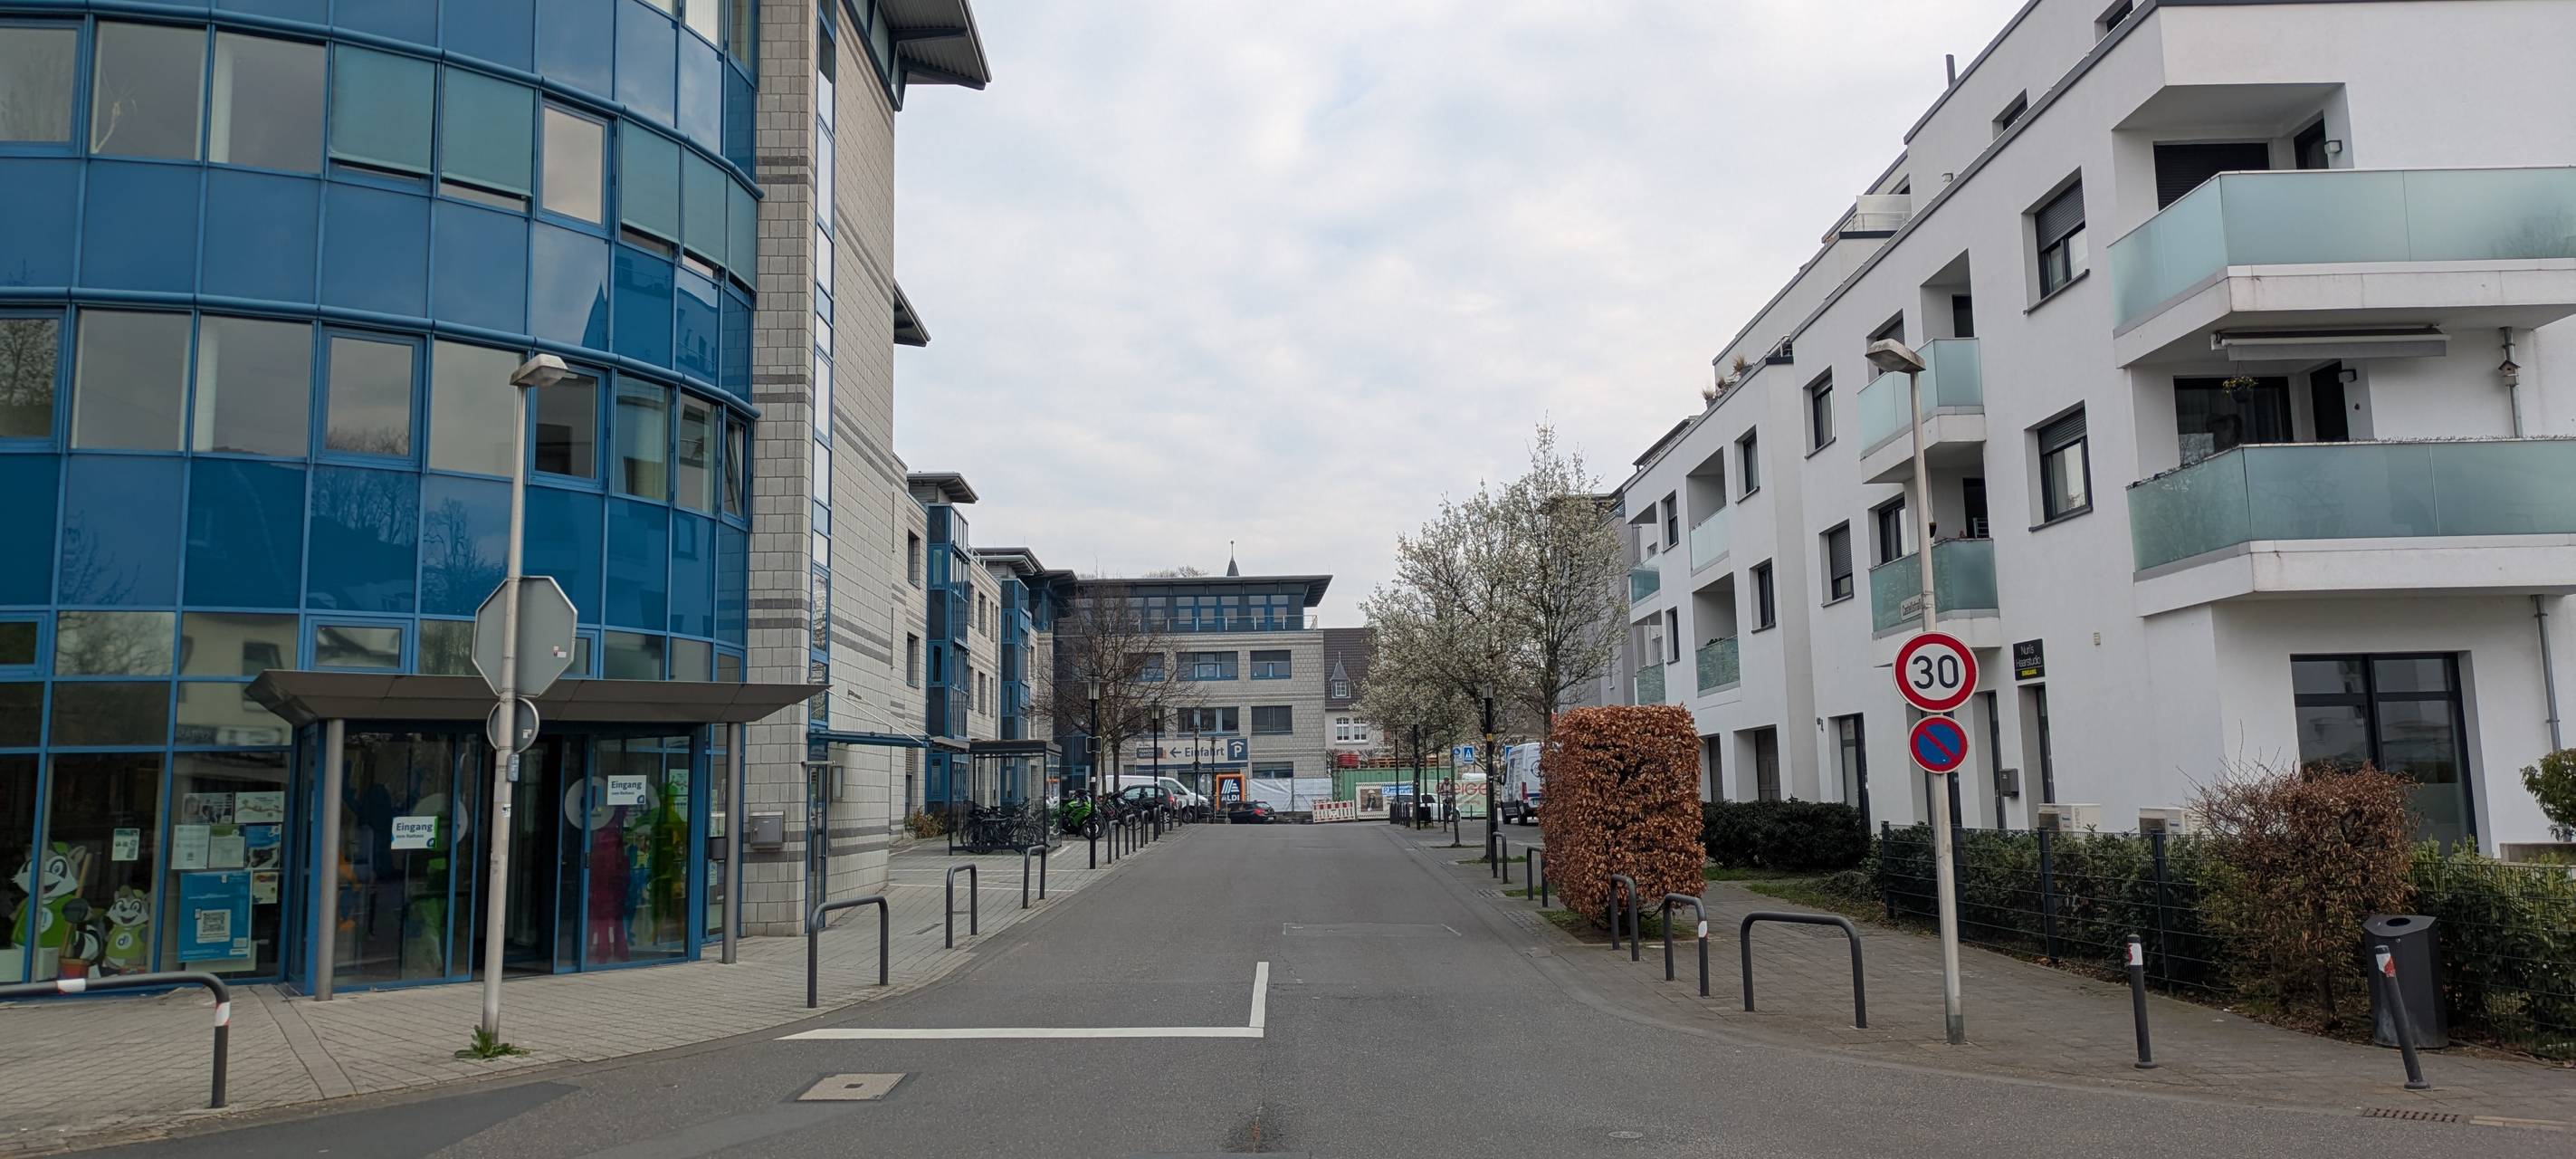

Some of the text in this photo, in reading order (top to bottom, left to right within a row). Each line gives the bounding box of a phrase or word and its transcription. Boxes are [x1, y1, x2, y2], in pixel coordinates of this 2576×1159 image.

[1912, 655, 1960, 689] 30
[611, 781, 643, 790] Eingang
[396, 822, 434, 833] Eingang
